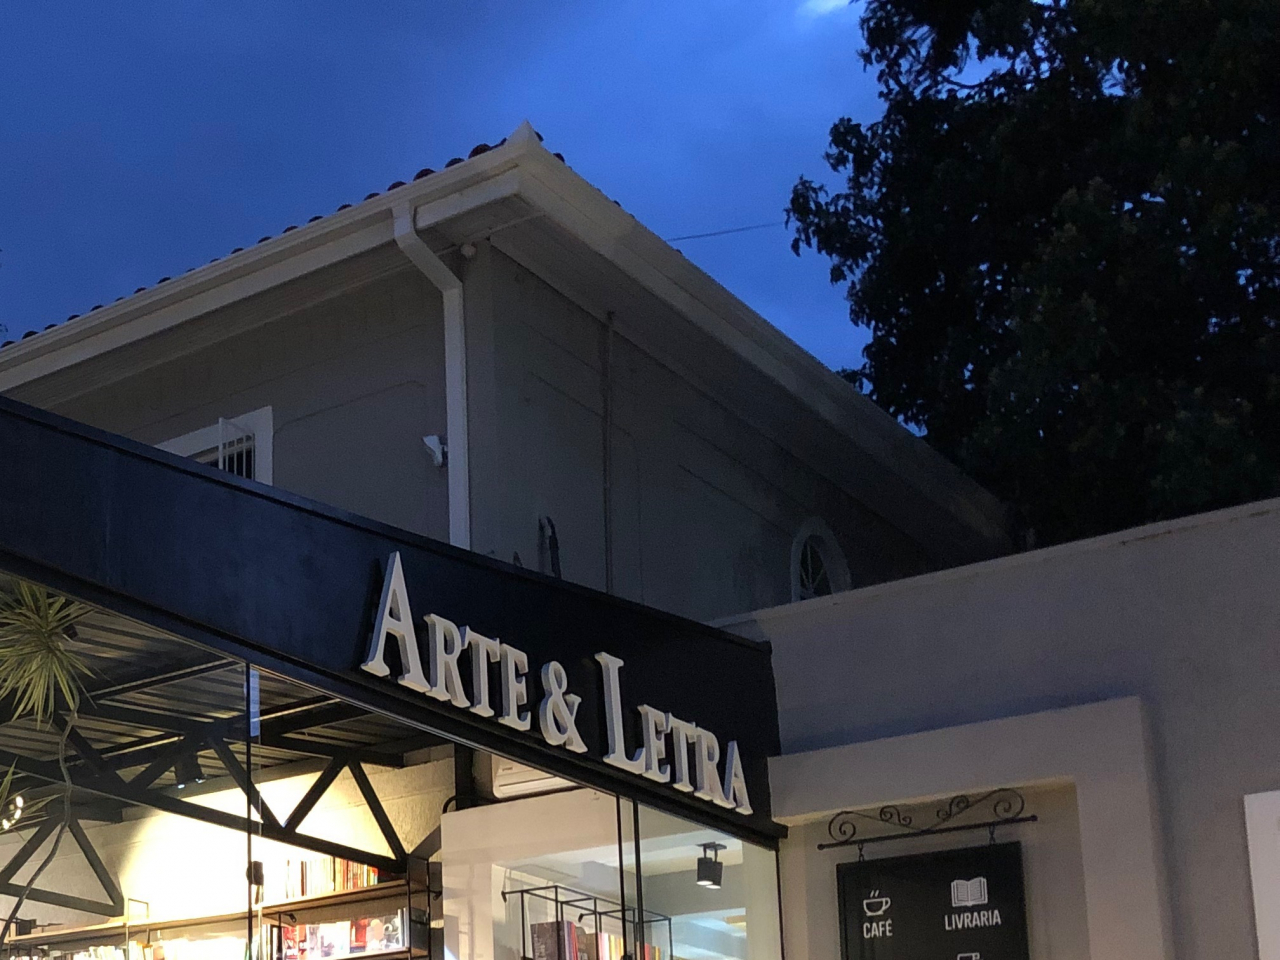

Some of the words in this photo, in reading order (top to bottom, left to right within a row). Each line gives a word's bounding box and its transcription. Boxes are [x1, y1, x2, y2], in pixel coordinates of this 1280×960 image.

[360, 551, 531, 731] ARTE
[539, 660, 588, 754] &
[595, 651, 754, 816] LETRA
[863, 918, 893, 939] CAFÉ
[944, 909, 1001, 931] LIVRARIA
